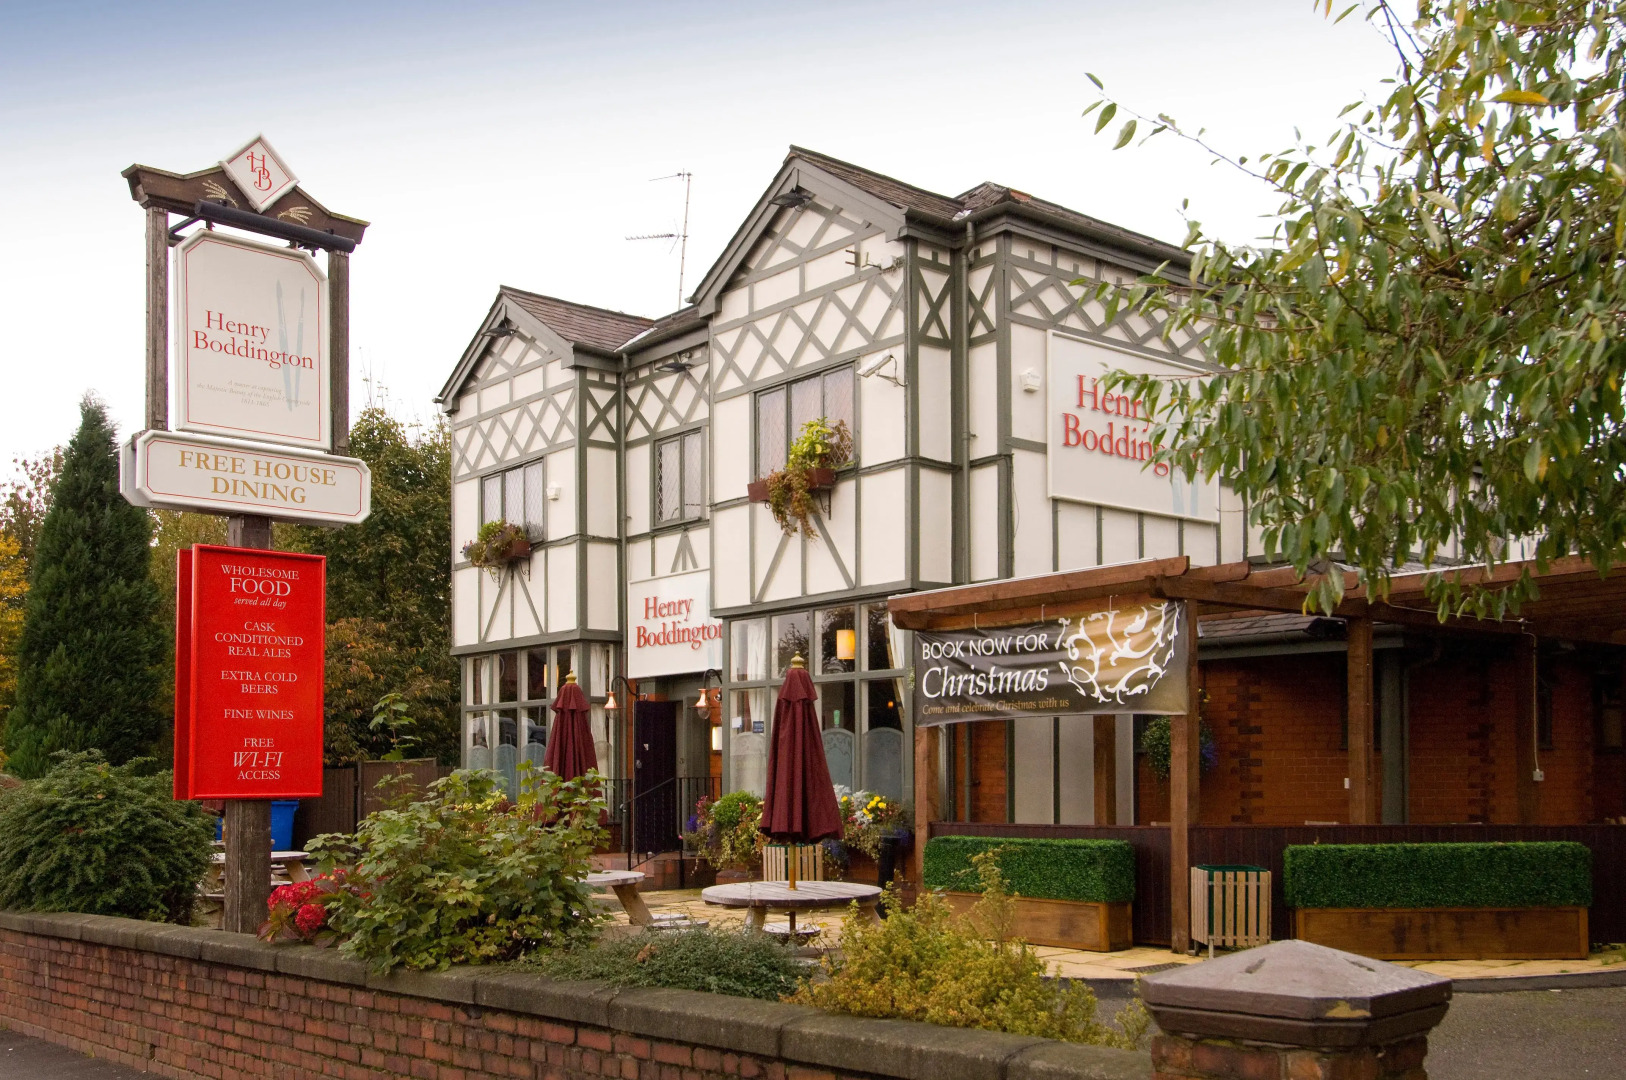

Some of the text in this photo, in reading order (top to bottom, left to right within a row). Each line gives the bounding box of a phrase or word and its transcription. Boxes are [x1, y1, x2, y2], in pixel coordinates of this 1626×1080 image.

[205, 309, 270, 344] Henry
[193, 330, 314, 370] Boddington
[1062, 412, 1204, 477] Bodding
[178, 450, 337, 486] FREE HOUSE
[211, 476, 307, 504] DINING
[221, 564, 300, 580] WHOLESOME
[230, 577, 291, 597] FOOD
[233, 597, 287, 610] served all day
[643, 596, 694, 622] Henry
[244, 621, 275, 633] CASK
[214, 632, 304, 647] CONDITIONED
[922, 633, 1049, 660] BOOK NOW FOR
[228, 646, 292, 659] REAL ALES
[221, 670, 298, 683] EXTRA COLD
[922, 664, 1049, 699] Christmas
[241, 683, 279, 695] BEERS
[223, 708, 294, 720] FINE WINES
[922, 697, 1069, 715] Come and celebrate Christmas with us
[244, 737, 275, 748] FREE
[233, 751, 284, 768] WI-FI
[237, 770, 281, 780] ACCESS
